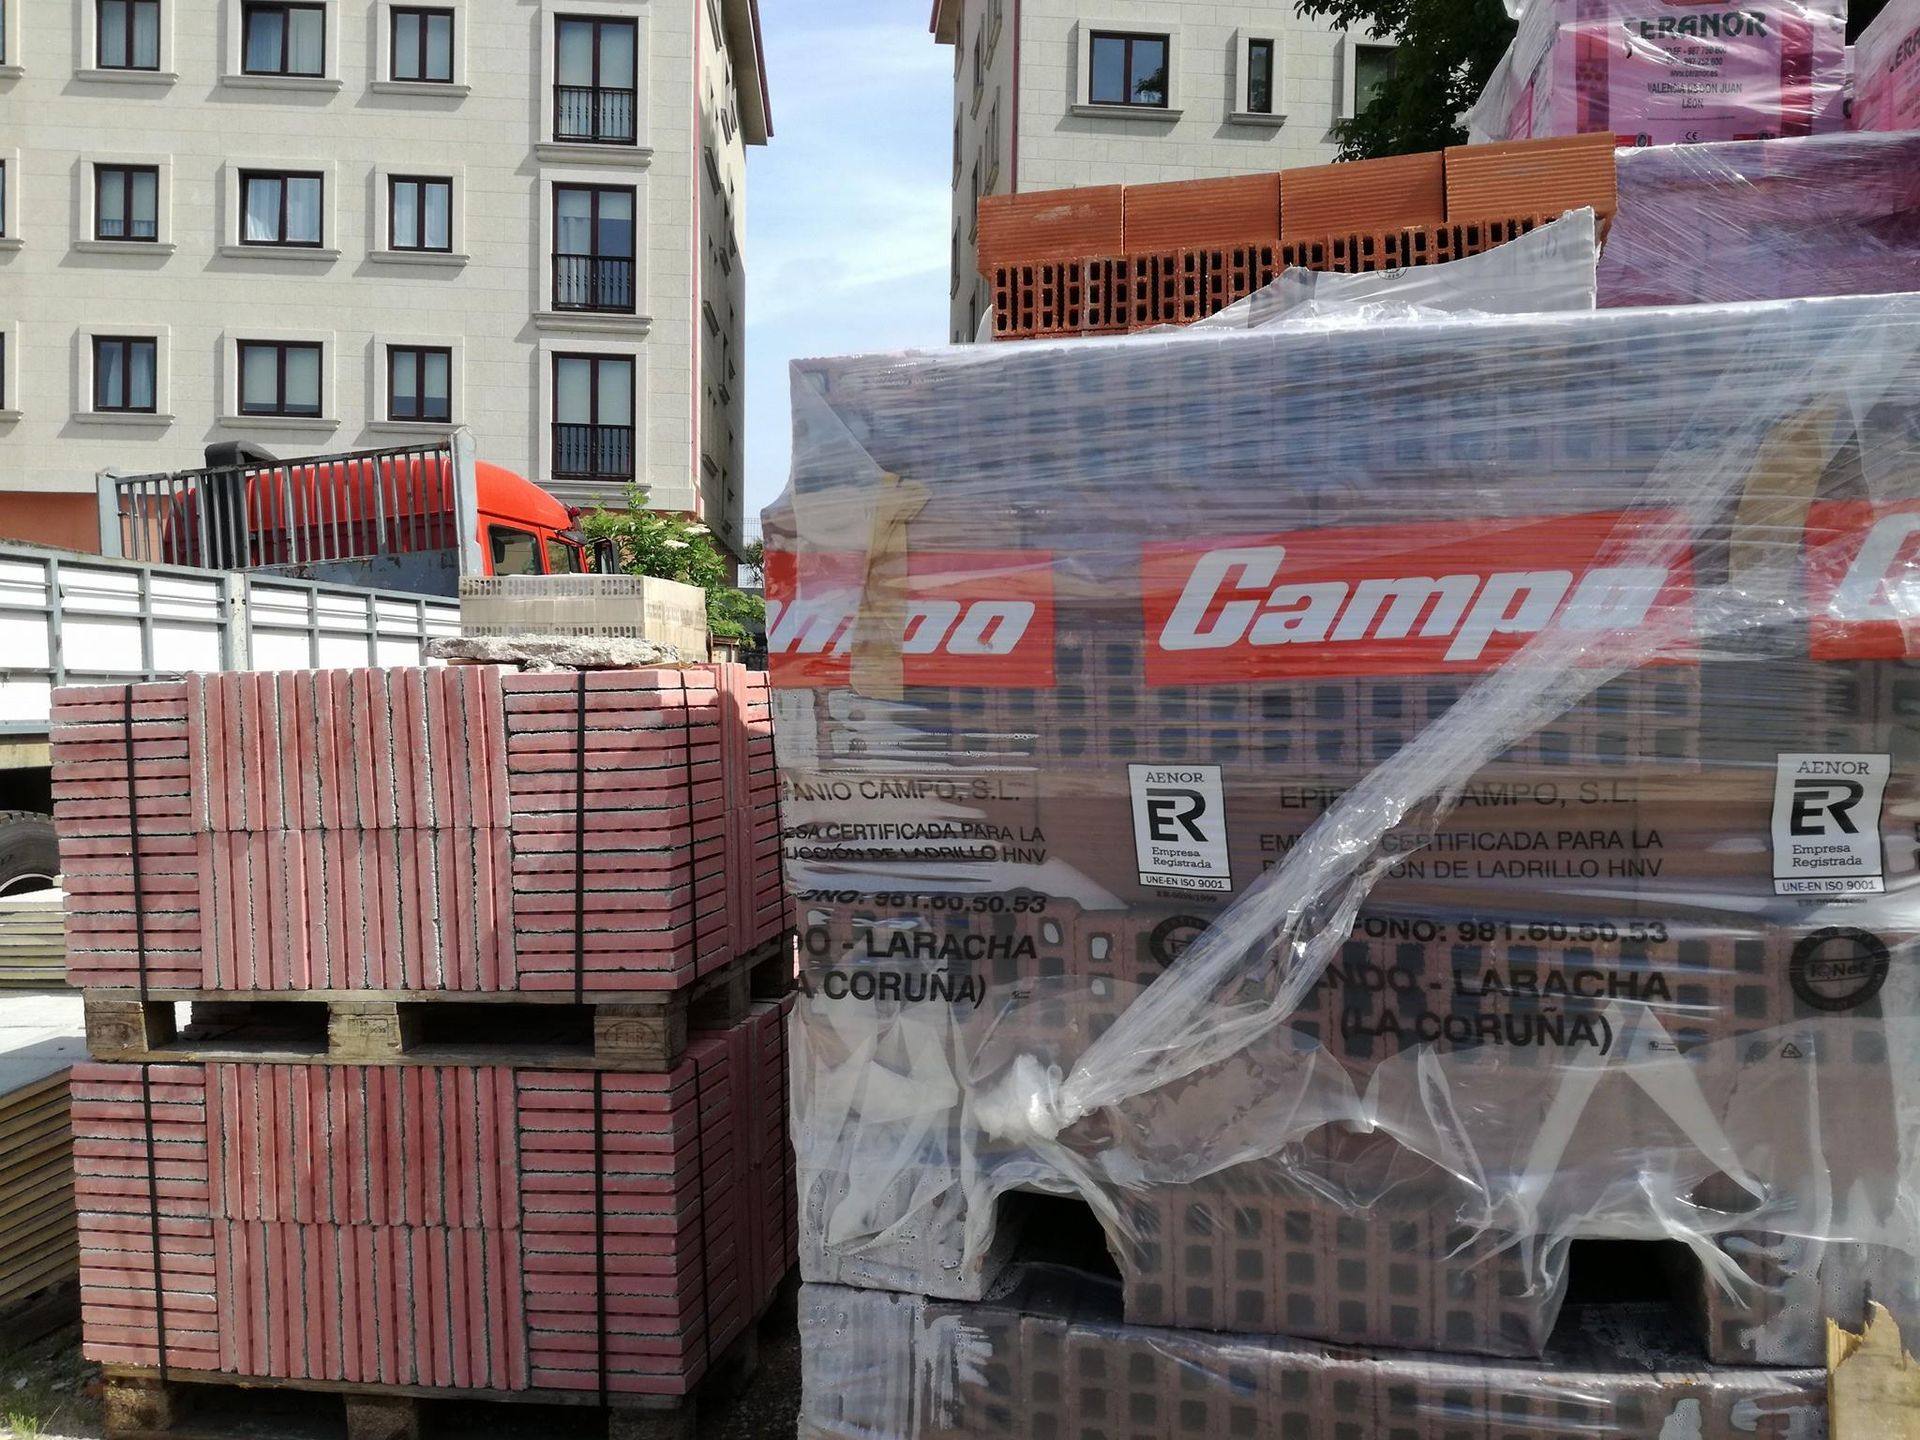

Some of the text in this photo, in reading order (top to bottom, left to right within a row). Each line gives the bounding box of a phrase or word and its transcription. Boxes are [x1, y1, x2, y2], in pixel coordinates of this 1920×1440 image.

[1719, 82, 1743, 93] JUAN
[1159, 545, 1669, 661] Campo
[1145, 771, 1205, 784] AENOR
[1796, 760, 1870, 776] AENOR
[783, 780, 852, 801] ANIO
[971, 778, 1021, 801] S.L.
[1446, 782, 1567, 808] AMPO,
[1579, 779, 1639, 804] S.L.
[825, 822, 958, 841] CERTIFICADA
[960, 822, 1015, 842] PARA
[1020, 825, 1046, 843] LA
[1381, 831, 1550, 852] CERTIFICADA
[1557, 830, 1624, 850] PARA
[1632, 829, 1664, 849] LA
[1003, 846, 1047, 865] HNV
[1152, 846, 1201, 859] Empresa
[1791, 844, 1851, 857] Empresa
[1153, 857, 1213, 870] Registrada
[1434, 860, 1469, 879] DE
[1477, 859, 1600, 879] LADRILLO
[1608, 857, 1664, 878] HNV
[1792, 856, 1864, 869] Registrada
[1145, 875, 1225, 889] UNE-EN ISO 9001
[1782, 881, 1877, 892] UNE-EN ISO 9001
[874, 890, 1046, 914] 981.60.50.53
[1457, 920, 1669, 944] 981.60.50.53
[866, 928, 1037, 960] LARACHA
[823, 967, 986, 1009] CORUÑA)
[1453, 968, 1673, 1002] LARACHA
[1340, 1006, 1613, 1056] (LA CORUÑA)
